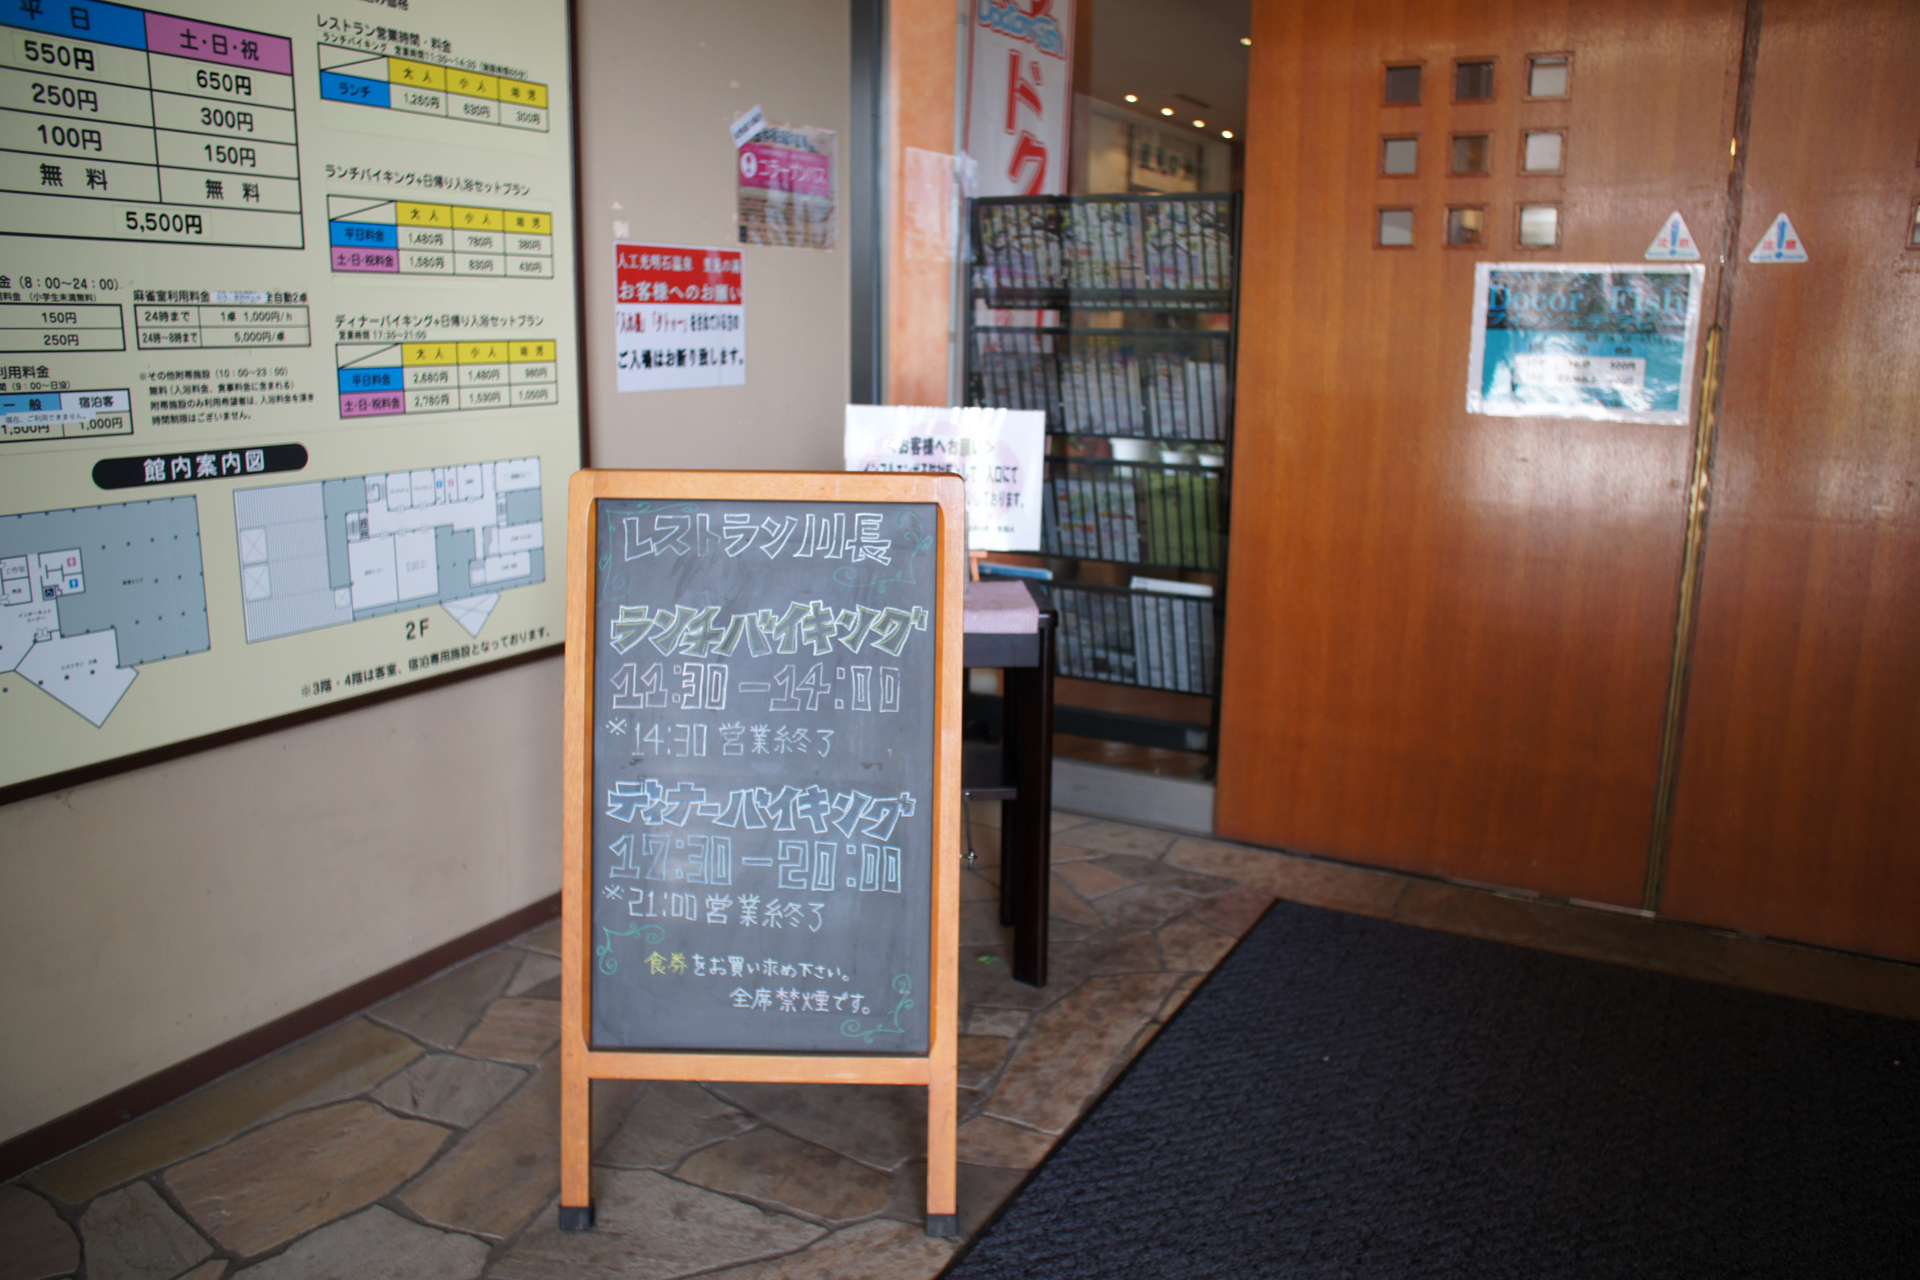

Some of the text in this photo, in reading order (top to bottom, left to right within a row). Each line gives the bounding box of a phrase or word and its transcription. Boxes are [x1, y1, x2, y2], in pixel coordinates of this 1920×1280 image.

[24, 40, 252, 96] 550円 650円
[338, 82, 371, 98] ランチ
[32, 83, 254, 132] 250円 300円
[37, 125, 256, 167] 100円 150円
[40, 163, 261, 203] 無料 無料
[126, 212, 203, 236] 5,500円
[345, 228, 386, 243] 平日料金
[134, 289, 211, 303] 麻雀室利用料金
[619, 280, 743, 302] お客様へのお願い
[1610, 285, 1683, 315] Fish
[41, 312, 78, 324] 150円
[145, 311, 190, 322] 24時まで
[44, 334, 80, 347] 250円
[351, 373, 392, 386] 平日料金
[79, 395, 115, 409] 宿泊客
[143, 449, 265, 483] 館内案内図
[623, 512, 892, 566] レストラン川長
[405, 619, 430, 641] 2F
[610, 600, 929, 657] ランチバイキング
[605, 779, 917, 841] ディナーバイキング
[643, 951, 851, 983] 食券をお買い求め下さい。
[729, 987, 871, 1015] 全席禁煙です。
